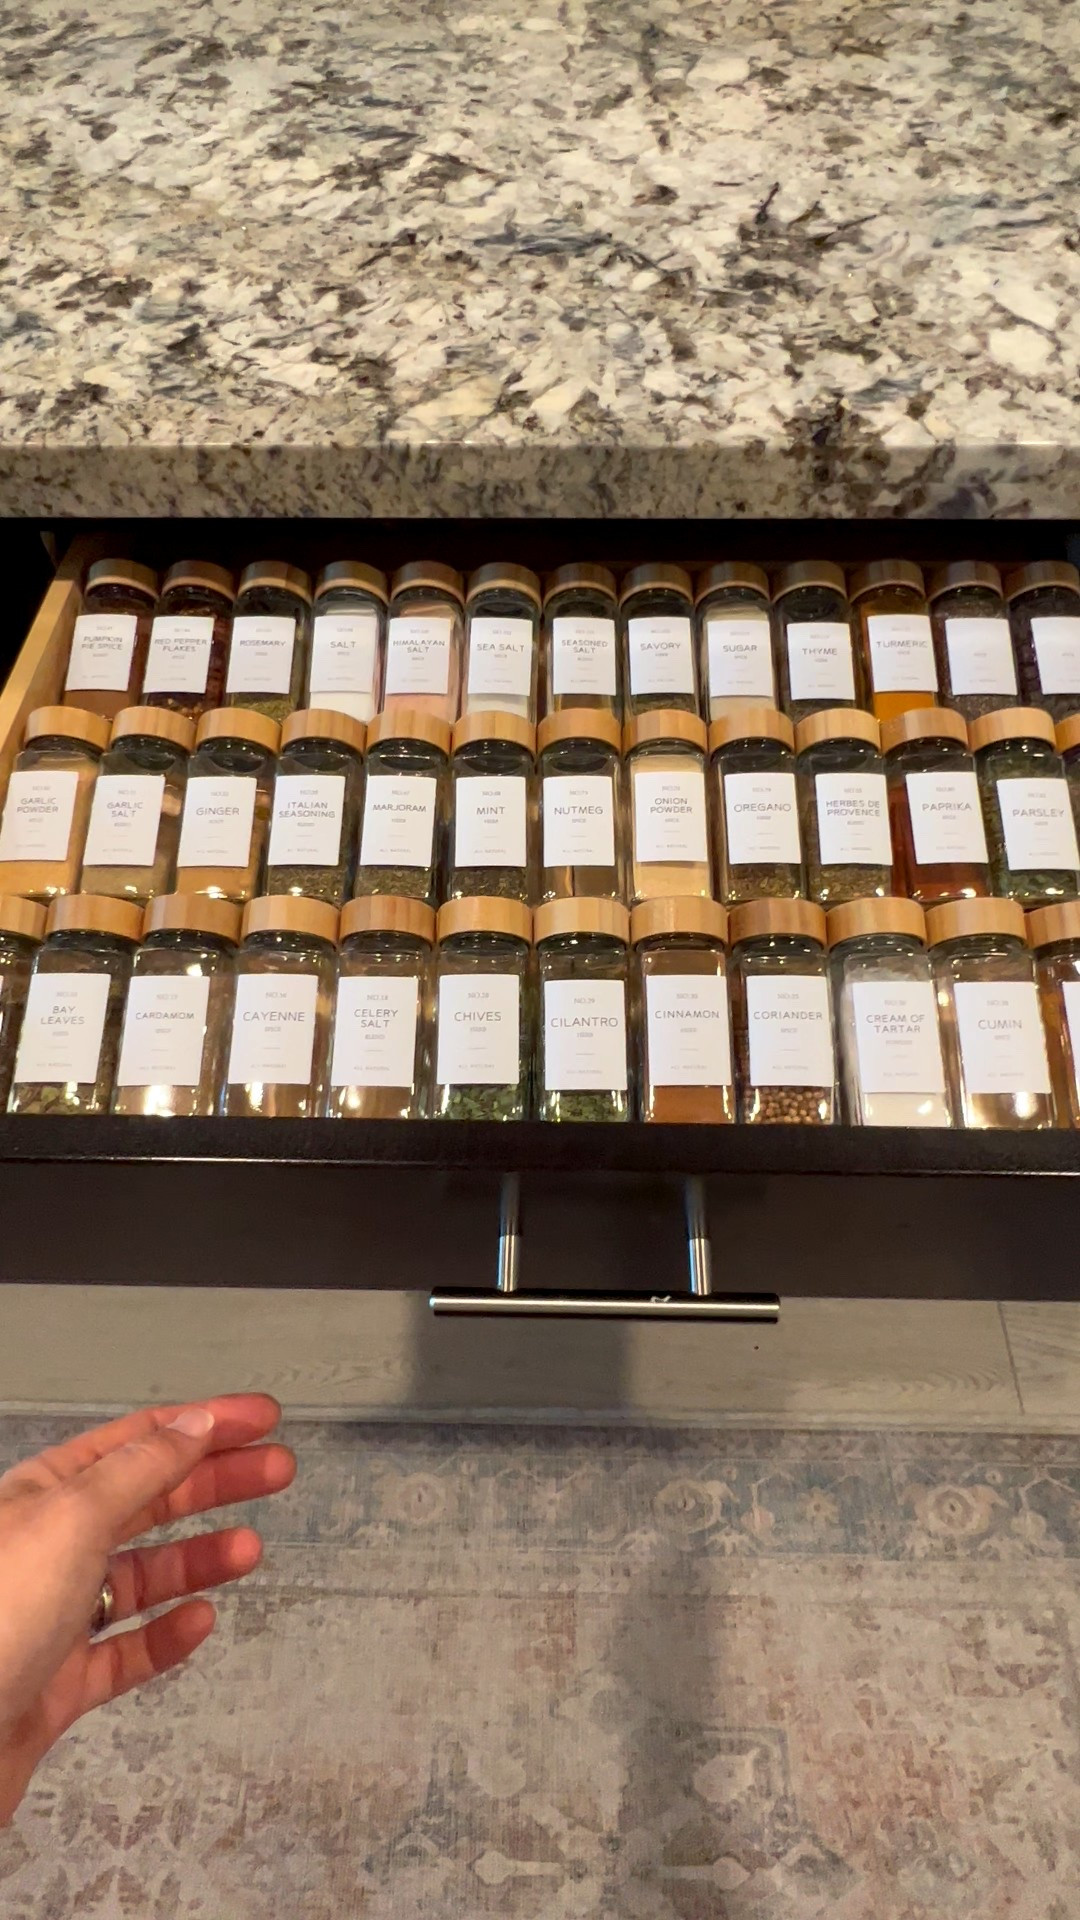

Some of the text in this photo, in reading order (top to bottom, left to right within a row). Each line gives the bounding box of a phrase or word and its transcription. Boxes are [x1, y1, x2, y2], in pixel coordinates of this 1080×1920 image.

[330, 641, 357, 649] SALT
[476, 643, 525, 652] SEA SALT
[640, 643, 681, 651] SAVORY
[801, 648, 838, 656] THYME
[21, 797, 57, 805] GARLIC
[654, 797, 688, 805] ONION
[825, 800, 880, 809] HERBES DE
[16, 806, 59, 814] POWDER
[372, 803, 427, 812] MARJORAM
[476, 806, 506, 815] MINT
[554, 806, 604, 815] NUTMEG
[650, 806, 693, 814] POWDER
[734, 803, 791, 812] OREGANO
[921, 802, 972, 811] PAPRIKA
[111, 810, 137, 818] SALT
[196, 807, 240, 816] GINGER
[279, 810, 336, 818] SEASONING
[826, 808, 881, 817] PROVENCE
[1012, 808, 1065, 818] PARSLEY
[52, 1005, 75, 1014] BAY
[353, 1008, 398, 1017] CELERY
[242, 1011, 306, 1022] CAYENNE
[454, 1011, 502, 1022] CHIVES
[654, 1010, 720, 1019] CINNAMON
[753, 1011, 823, 1020] CORIANDER
[866, 1014, 925, 1024] CREAM OF
[40, 1016, 86, 1025] LEAVES
[360, 1019, 390, 1028] SALT
[550, 1017, 619, 1028] CILANTRO
[977, 1019, 1023, 1030] CUMIN
[873, 1025, 921, 1033] TARTAR
